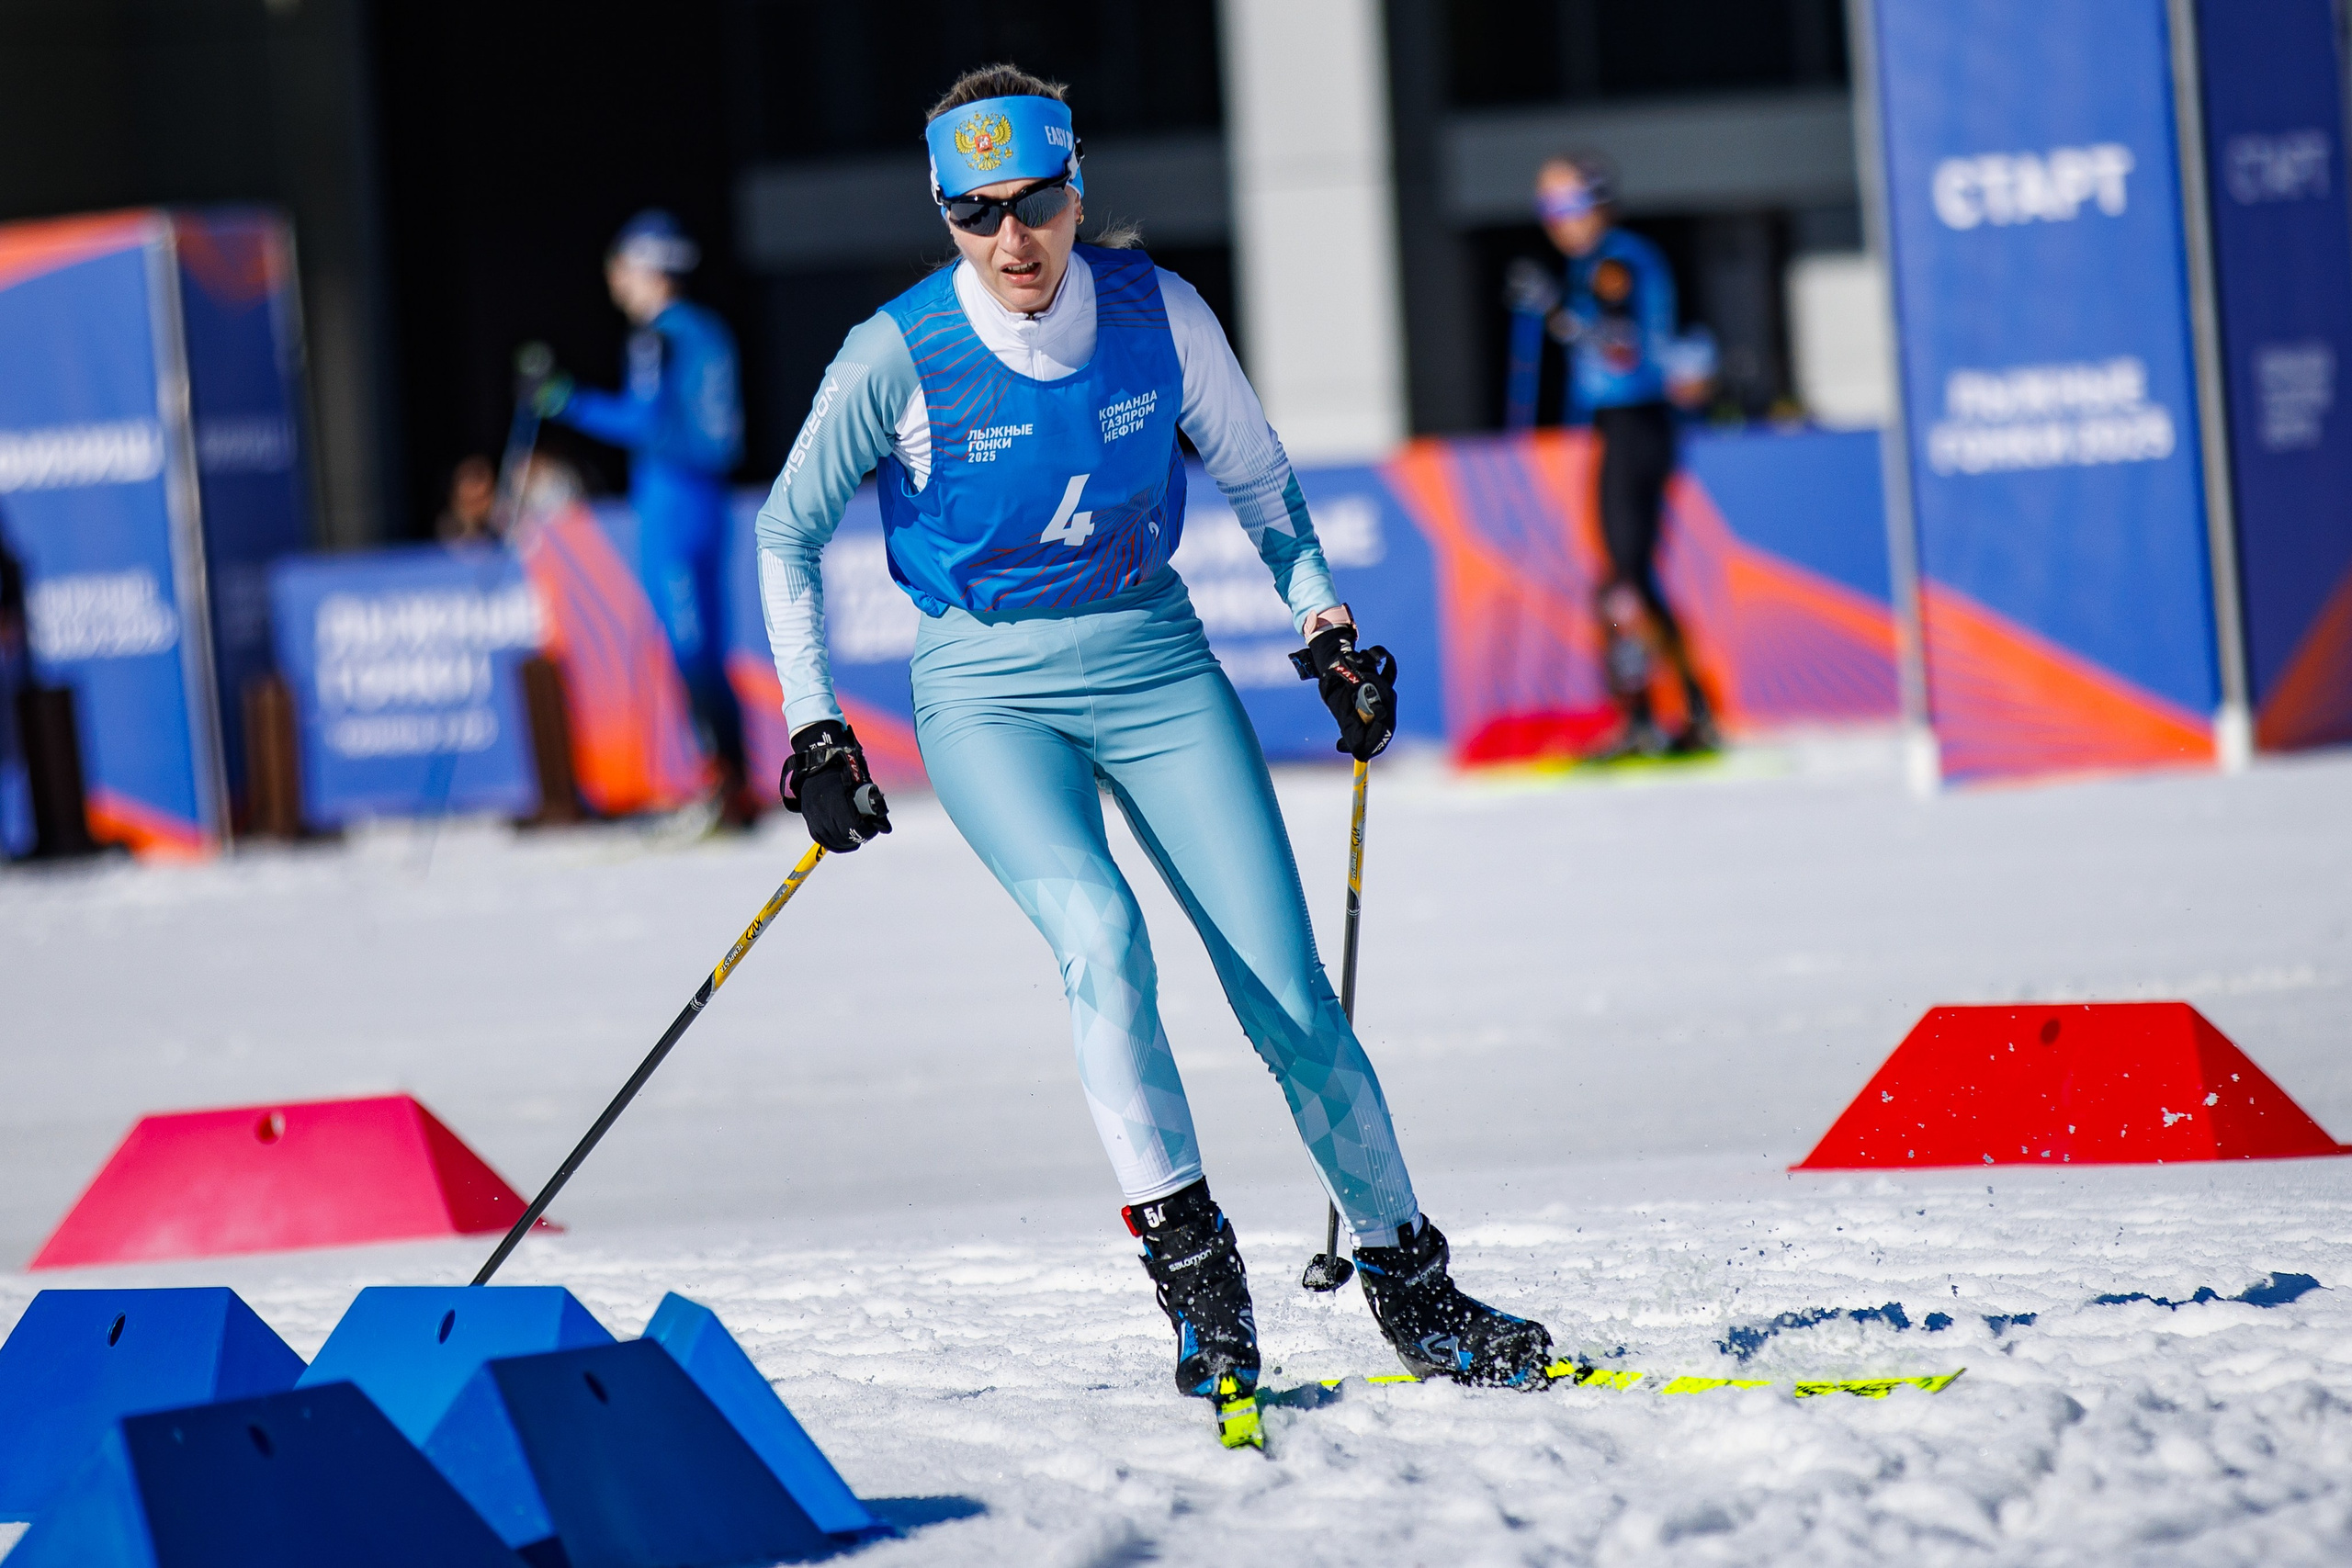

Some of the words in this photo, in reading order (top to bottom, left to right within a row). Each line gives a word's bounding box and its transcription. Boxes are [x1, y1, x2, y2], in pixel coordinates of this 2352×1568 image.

[1934, 144, 2134, 229] СТАРТ
[1099, 389, 1158, 421] КОМАНДА
[1102, 402, 1155, 433] ГАЗПРОМ
[967, 423, 1034, 441] ЛЫЖНЫЕ
[968, 437, 1012, 452] ГОНКИ
[1104, 418, 1144, 444] НЕФТИ
[967, 450, 996, 463] 2025
[1039, 473, 1095, 547] 4
[719, 942, 744, 974] TEMPESTA
